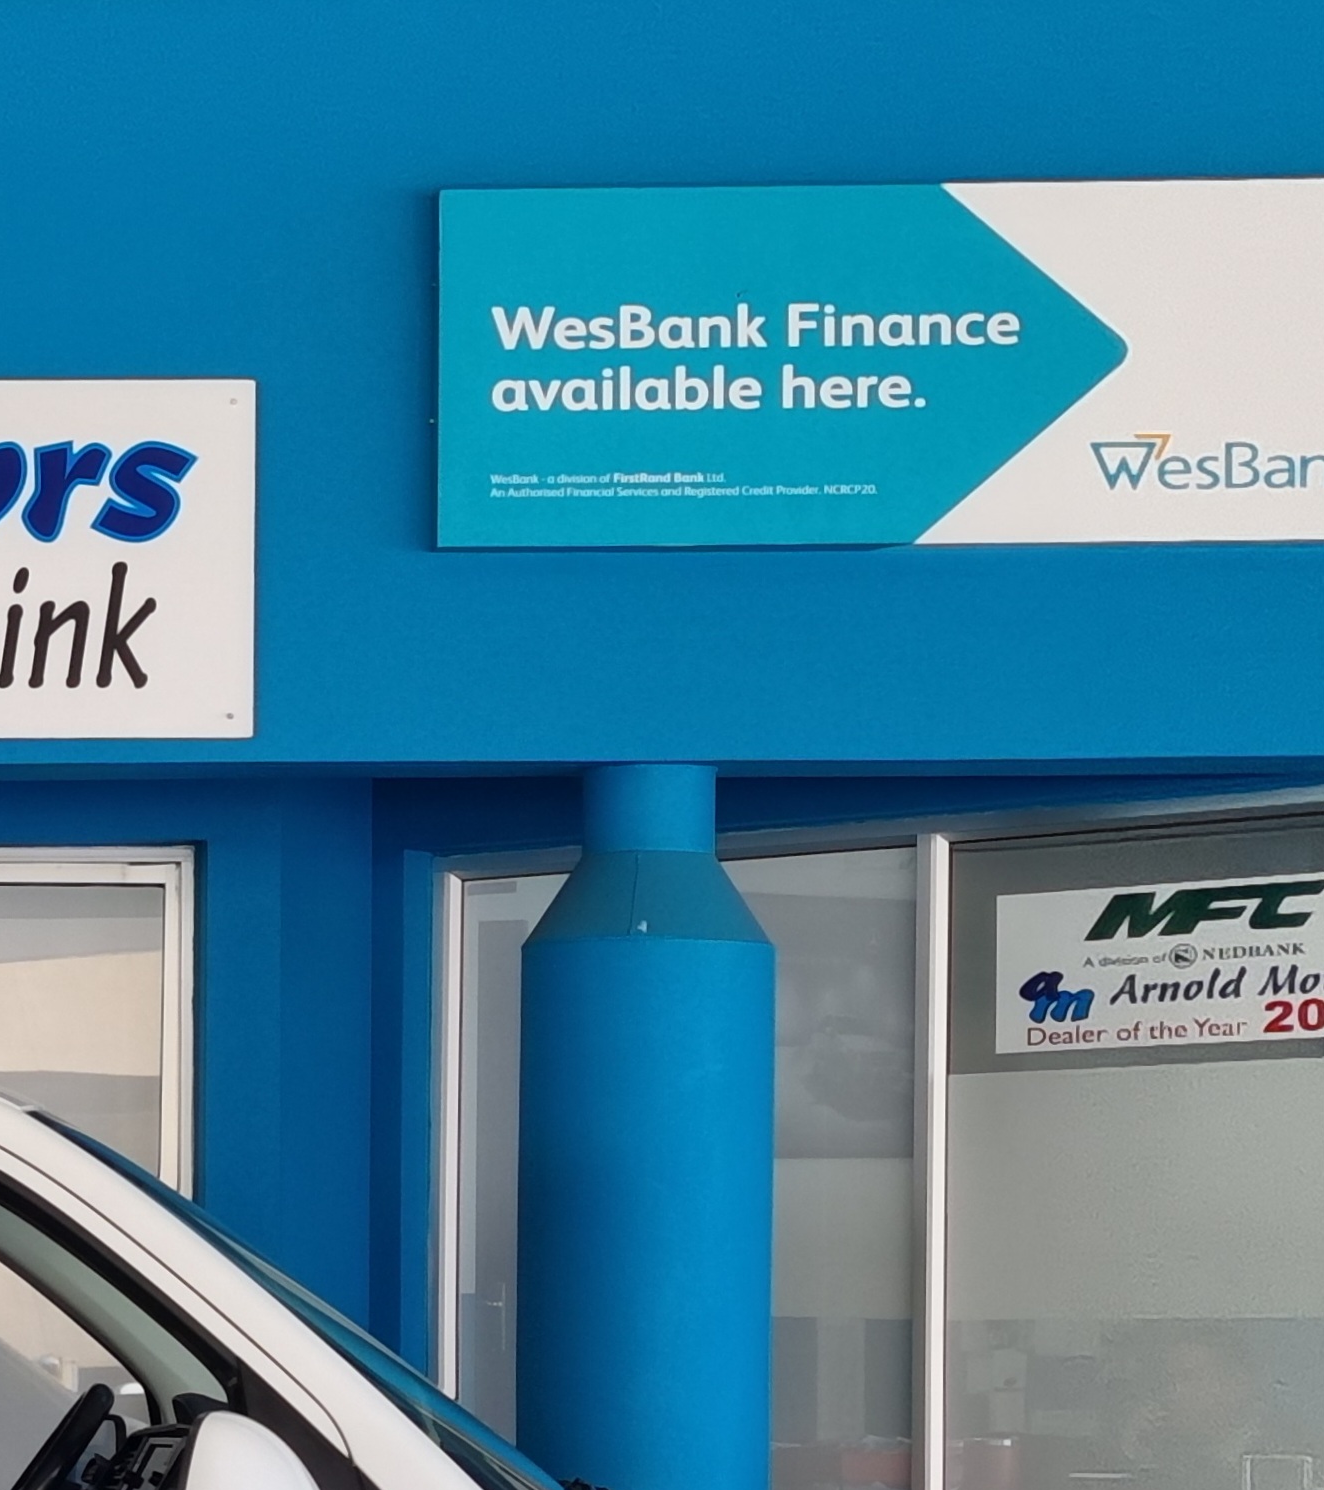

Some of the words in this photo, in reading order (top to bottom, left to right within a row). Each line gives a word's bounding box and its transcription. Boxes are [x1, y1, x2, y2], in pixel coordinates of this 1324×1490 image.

[491, 302, 768, 351] WesBank
[787, 302, 1021, 348] Finance
[491, 364, 763, 412] available
[782, 363, 927, 409] here.
[489, 473, 539, 485] WesBank
[547, 475, 554, 484] a
[556, 473, 597, 484] division
[598, 473, 611, 484] of
[613, 472, 671, 483] FirstRand
[673, 472, 704, 483] Bank
[706, 473, 726, 483] Ltd.
[489, 487, 505, 498] An
[507, 487, 565, 498] Authorised
[567, 487, 615, 497] Financial
[616, 486, 659, 497] Services
[661, 486, 682, 497] and
[684, 486, 739, 498] Registered
[741, 485, 774, 496] Credit
[1083, 879, 1324, 942] MFC
[1082, 956, 1096, 968] A
[1202, 942, 1306, 961] NEDBANK
[1109, 966, 1247, 1005] Arnold
[1257, 963, 1324, 996] Mo
[1026, 1024, 1109, 1047] Dealer
[1116, 1020, 1143, 1042] of
[1149, 1020, 1188, 1041] the
[1193, 1017, 1248, 1038] Year
[1262, 997, 1324, 1034] 20
